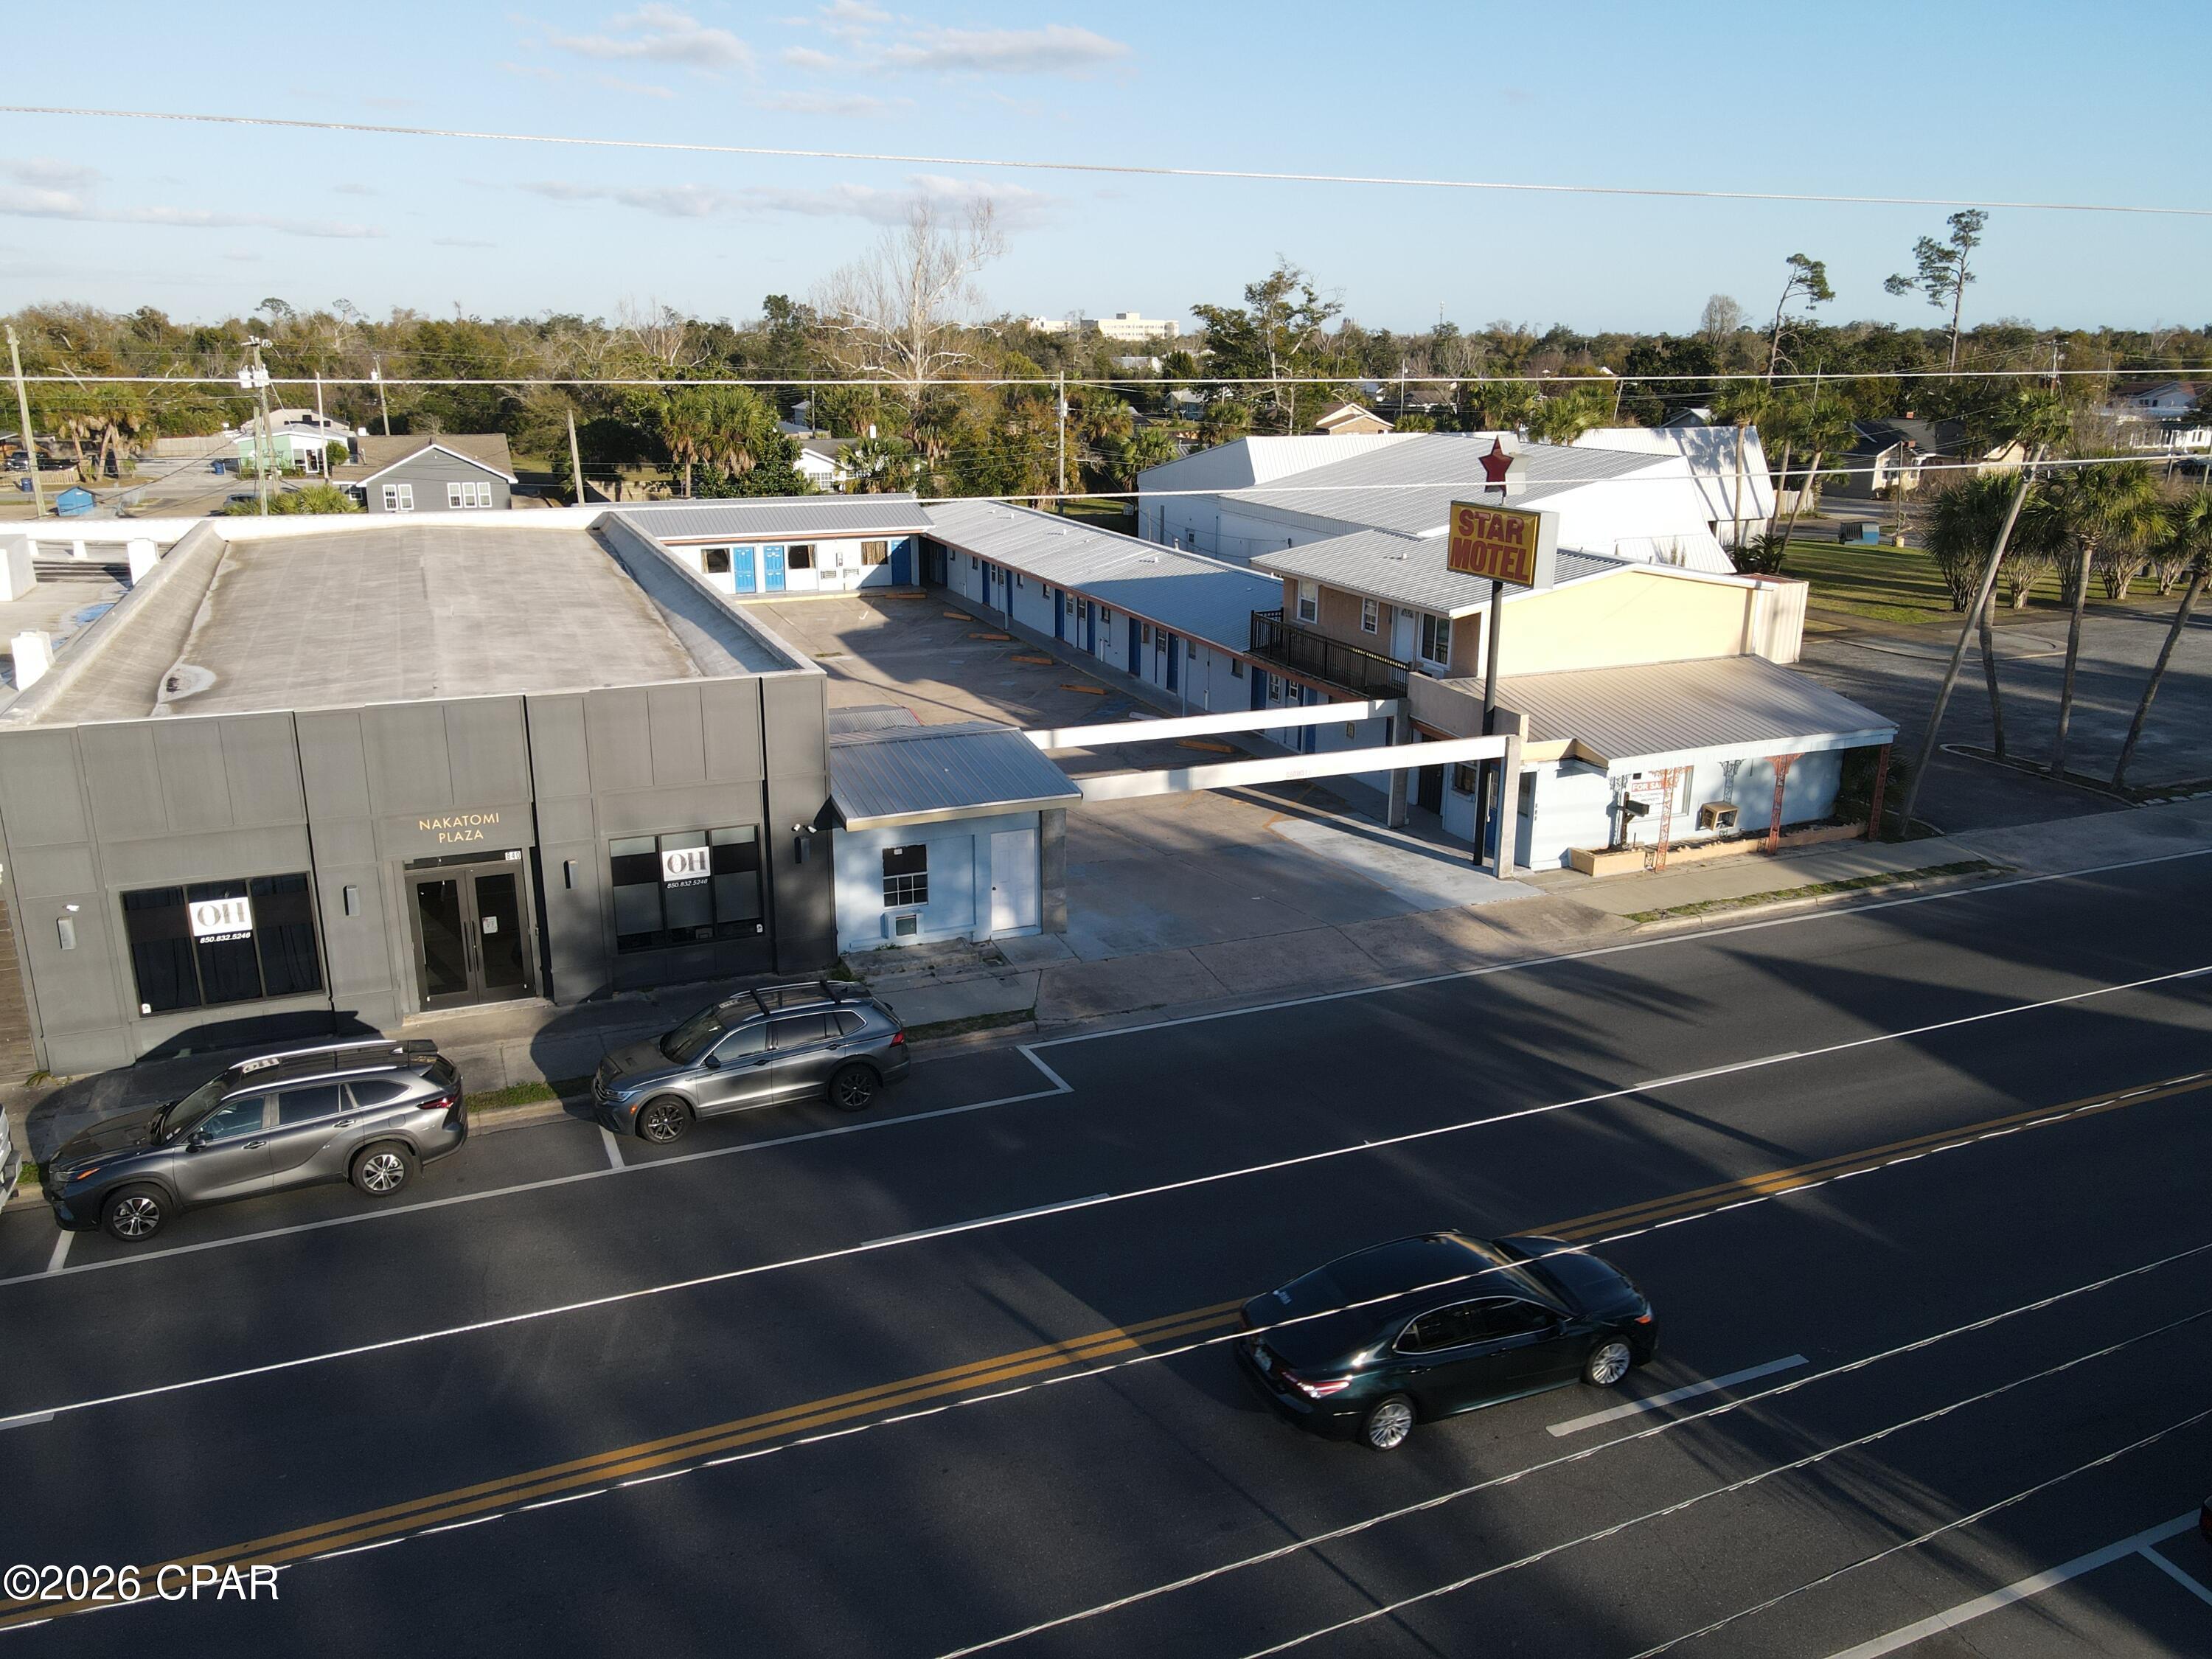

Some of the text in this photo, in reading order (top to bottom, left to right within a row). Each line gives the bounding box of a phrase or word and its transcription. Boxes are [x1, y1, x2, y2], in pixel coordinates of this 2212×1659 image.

[1458, 509, 1525, 545] STAR
[1450, 537, 1528, 581] MOTEL
[1632, 783, 1649, 791] FOR
[419, 813, 500, 831] NAKATOMI
[439, 830, 484, 844] PLAZA
[507, 851, 521, 860] 840
[667, 851, 707, 874] OH
[197, 902, 246, 927] OH
